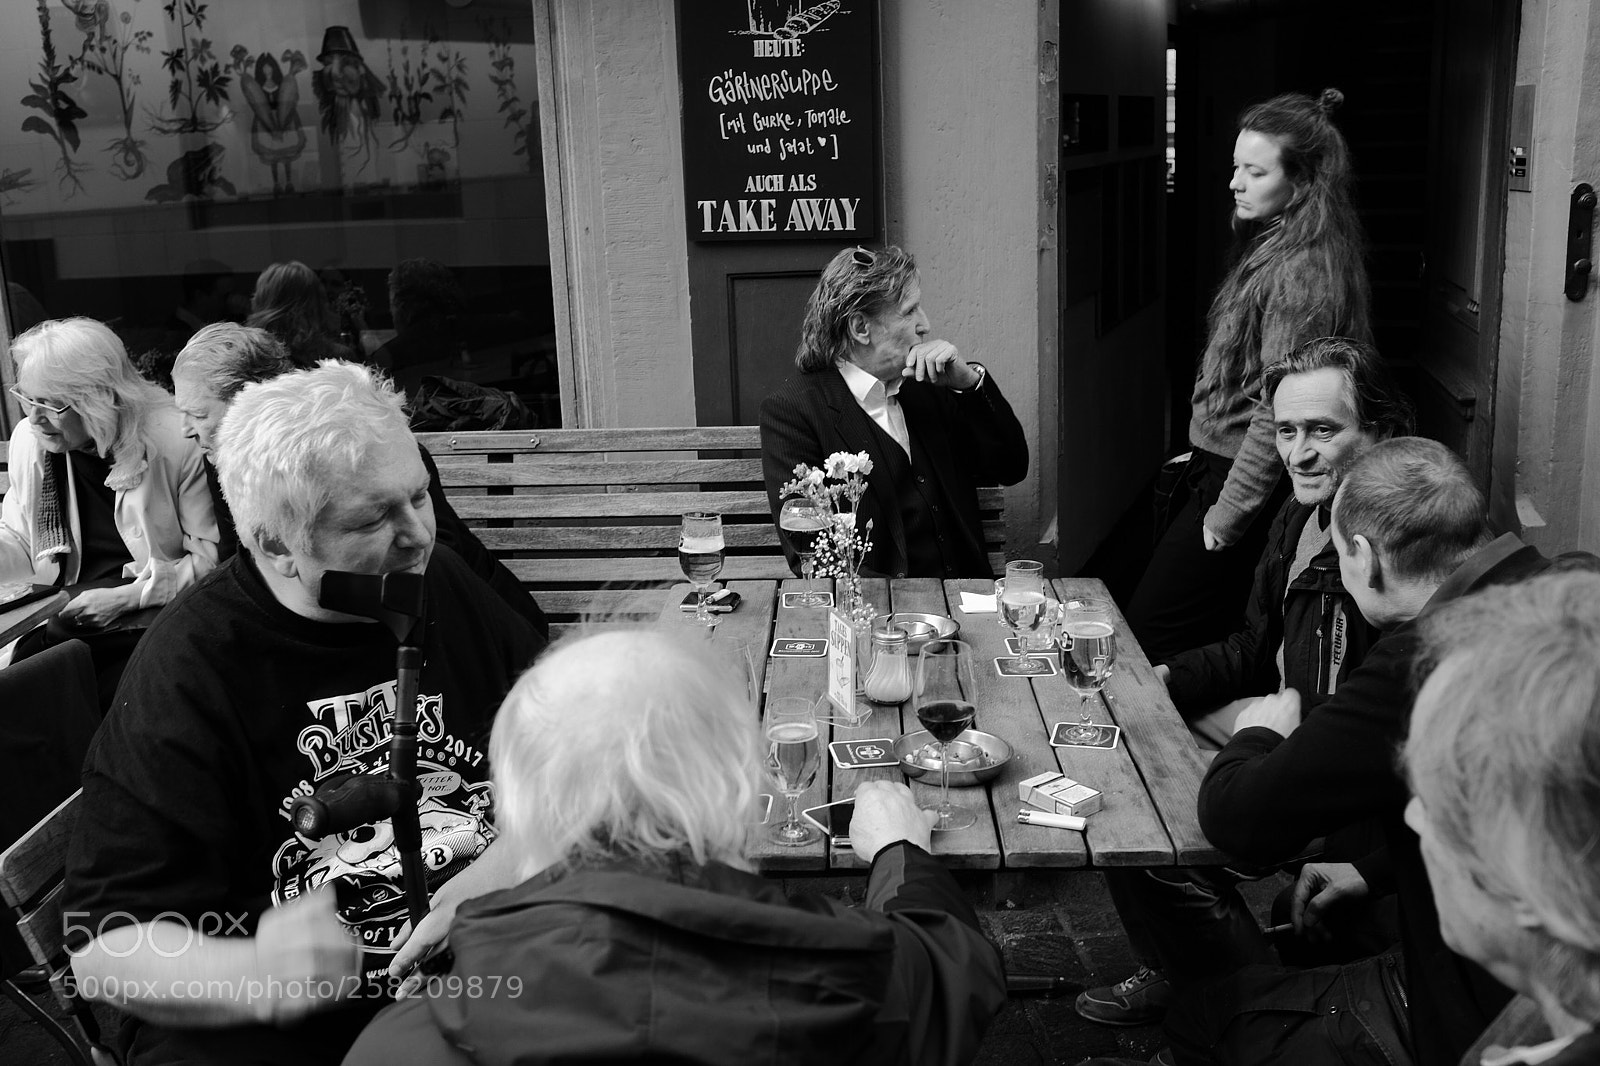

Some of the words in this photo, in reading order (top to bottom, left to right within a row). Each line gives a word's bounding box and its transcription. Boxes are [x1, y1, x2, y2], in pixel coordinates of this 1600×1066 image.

[753, 39, 805, 58] HEUTE:
[747, 138, 772, 155] und
[744, 175, 785, 193] AUCH
[788, 174, 818, 192] ALS
[697, 199, 778, 233] TAKE
[784, 198, 861, 232] AWAY
[1333, 617, 1344, 666] TECWEAR
[444, 735, 484, 767] 2017
